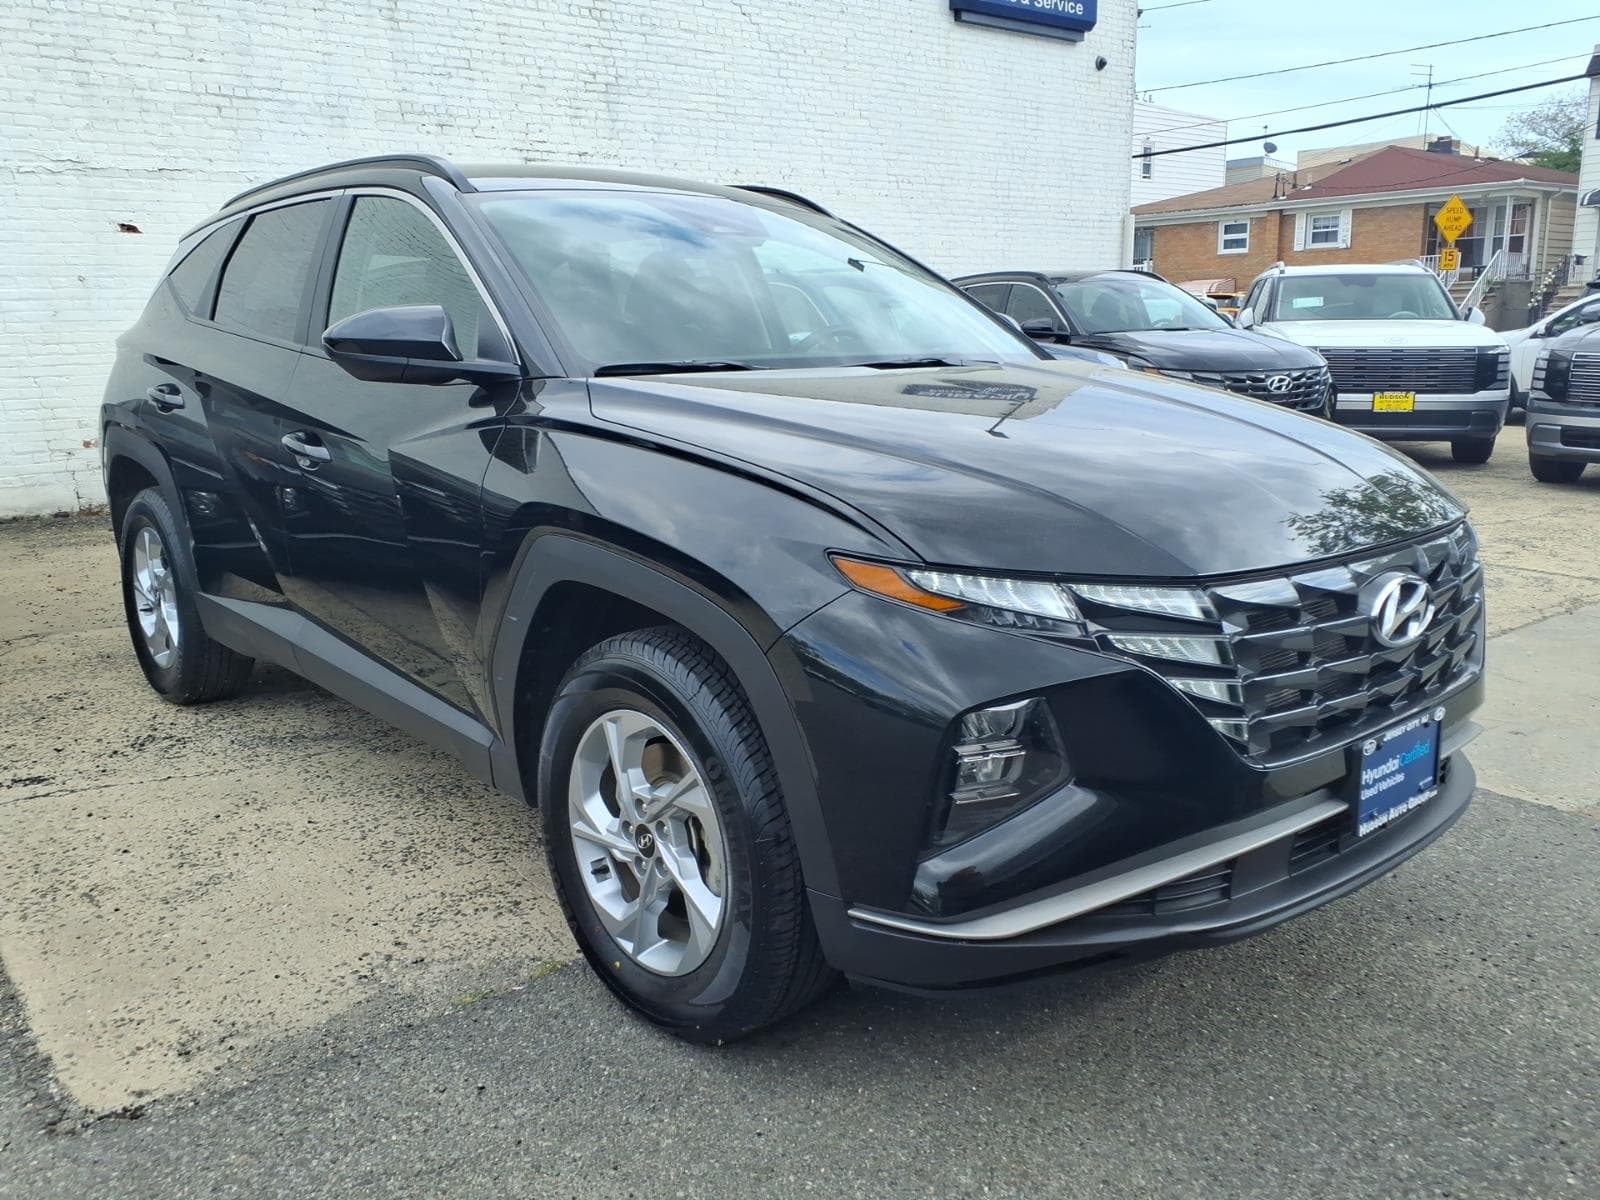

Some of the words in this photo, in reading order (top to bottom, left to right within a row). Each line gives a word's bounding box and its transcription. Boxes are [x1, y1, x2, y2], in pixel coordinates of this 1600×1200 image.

[1034, 0, 1084, 15] Service
[1444, 251, 1454, 262] 15
[1362, 755, 1400, 785] Hyundai
[1400, 739, 1430, 766] Certified
[1361, 781, 1379, 800] Used
[1379, 772, 1406, 792] Vehicles
